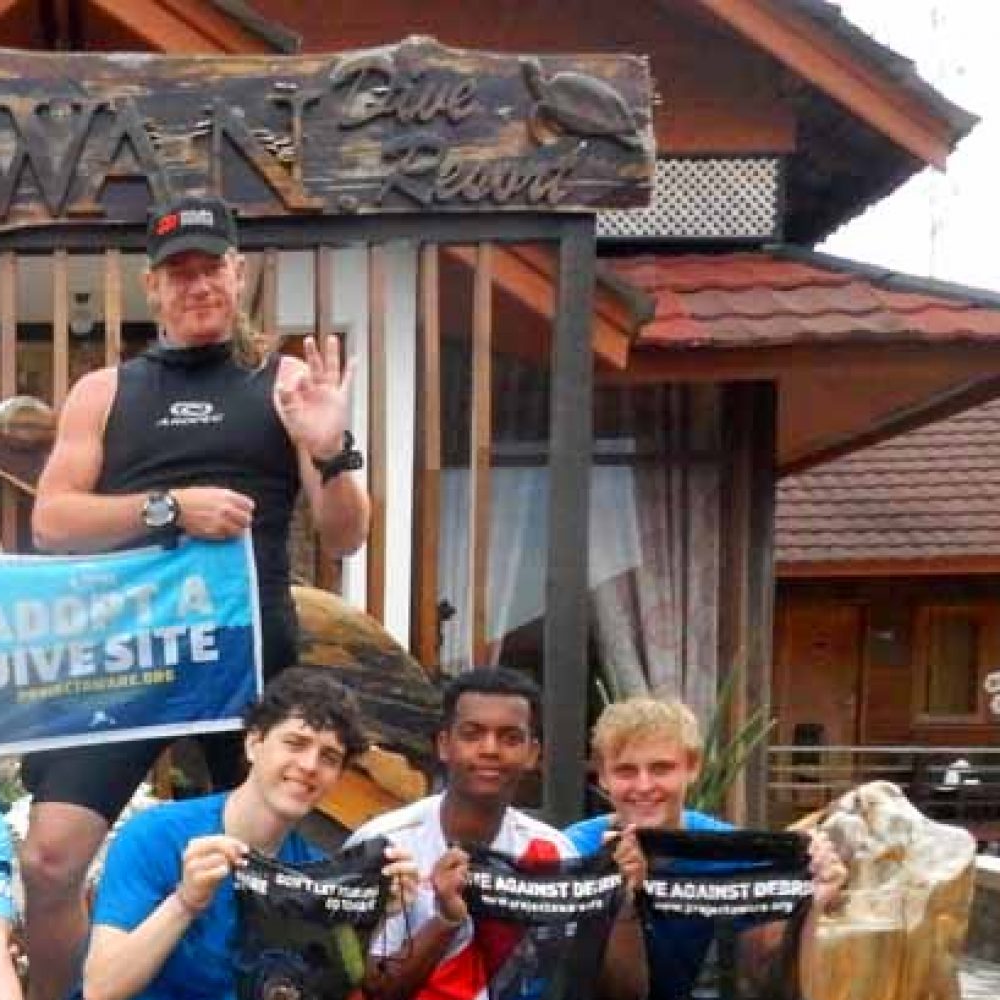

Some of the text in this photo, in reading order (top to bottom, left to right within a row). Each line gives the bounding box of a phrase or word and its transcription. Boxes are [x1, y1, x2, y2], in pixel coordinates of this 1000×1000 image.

[330, 50, 477, 131] Dive
[177, 573, 213, 616] A
[104, 622, 220, 680] SITE
[495, 876, 569, 899] AGAINST
[670, 881, 751, 901] AGAINST
